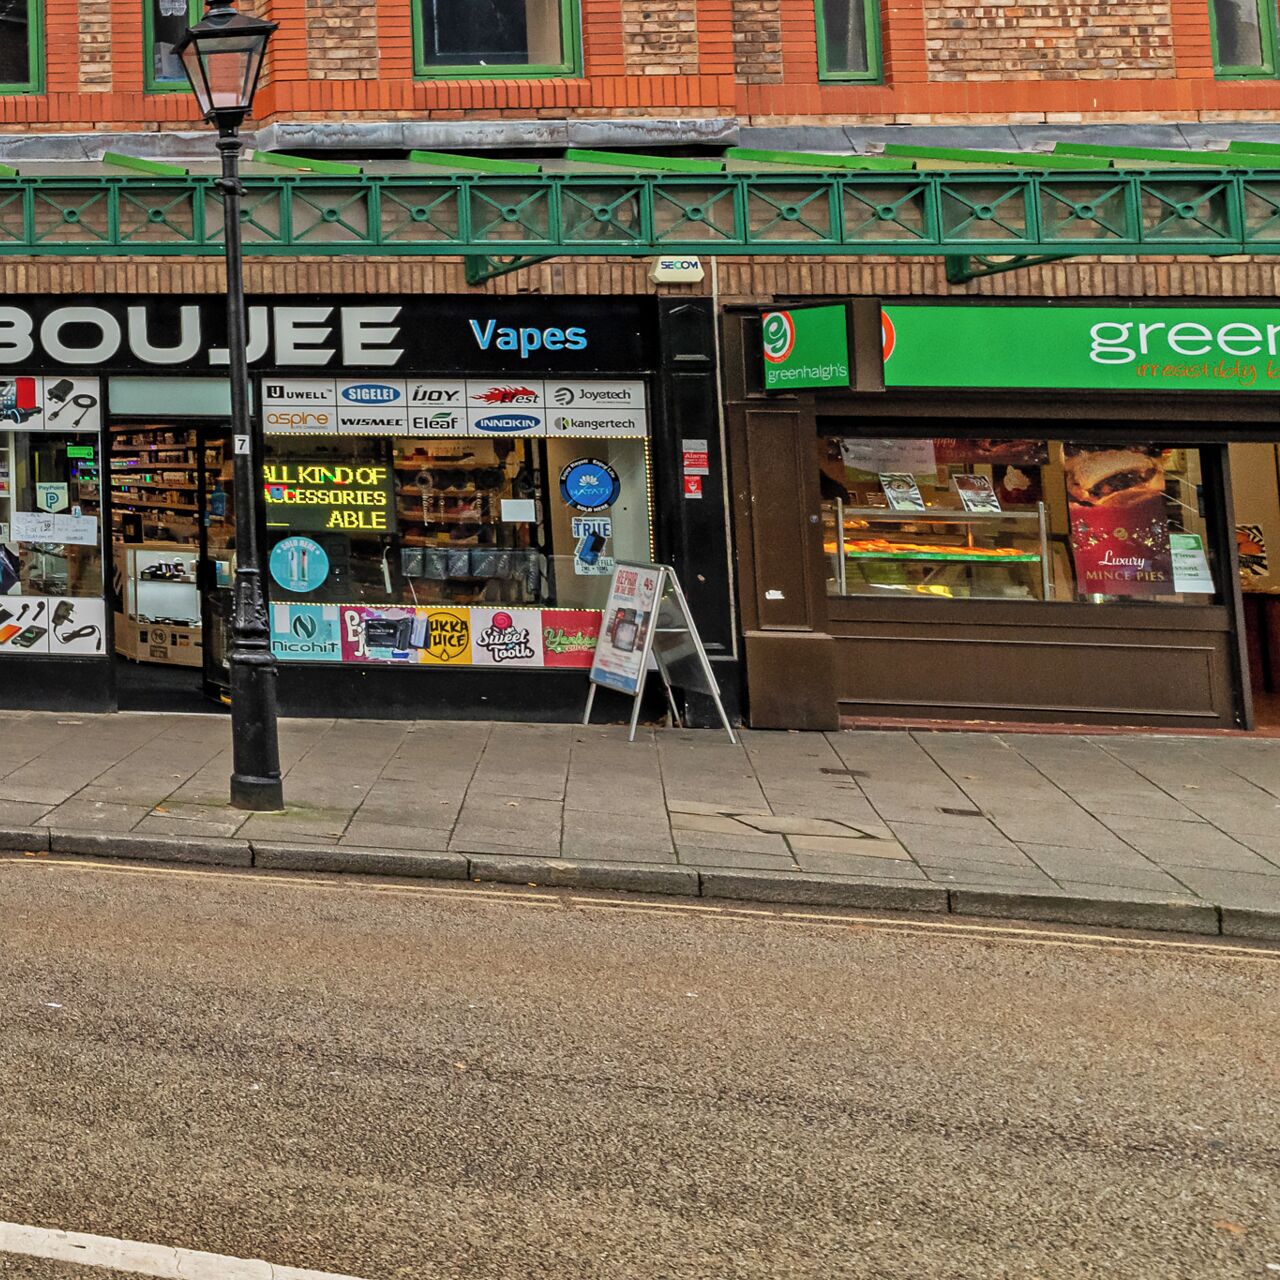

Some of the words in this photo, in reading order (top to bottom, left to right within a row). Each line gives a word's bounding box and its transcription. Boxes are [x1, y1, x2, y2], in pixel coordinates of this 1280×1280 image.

[660, 260, 699, 270] SECOM
[469, 319, 588, 358] Vapes
[768, 364, 848, 384] greenhalgh's
[286, 391, 327, 400] UWELL
[348, 388, 394, 401] SIGELEI
[579, 389, 632, 401] Joyetech
[266, 411, 329, 429] aspire
[341, 418, 404, 426] WISMEC
[413, 417, 459, 429] Eleaf
[480, 418, 536, 428] INNOKIN
[571, 417, 636, 429] kangertech
[237, 439, 247, 451] 7
[298, 466, 354, 484] KIND
[355, 467, 387, 485] OF
[574, 522, 610, 536] TRUE
[1098, 549, 1146, 569] Luxury
[1086, 570, 1132, 581] MINCE
[1135, 571, 1166, 582] PIES
[429, 619, 469, 633] UKKA
[476, 627, 529, 645] Sweet
[488, 645, 534, 662] Tooth
